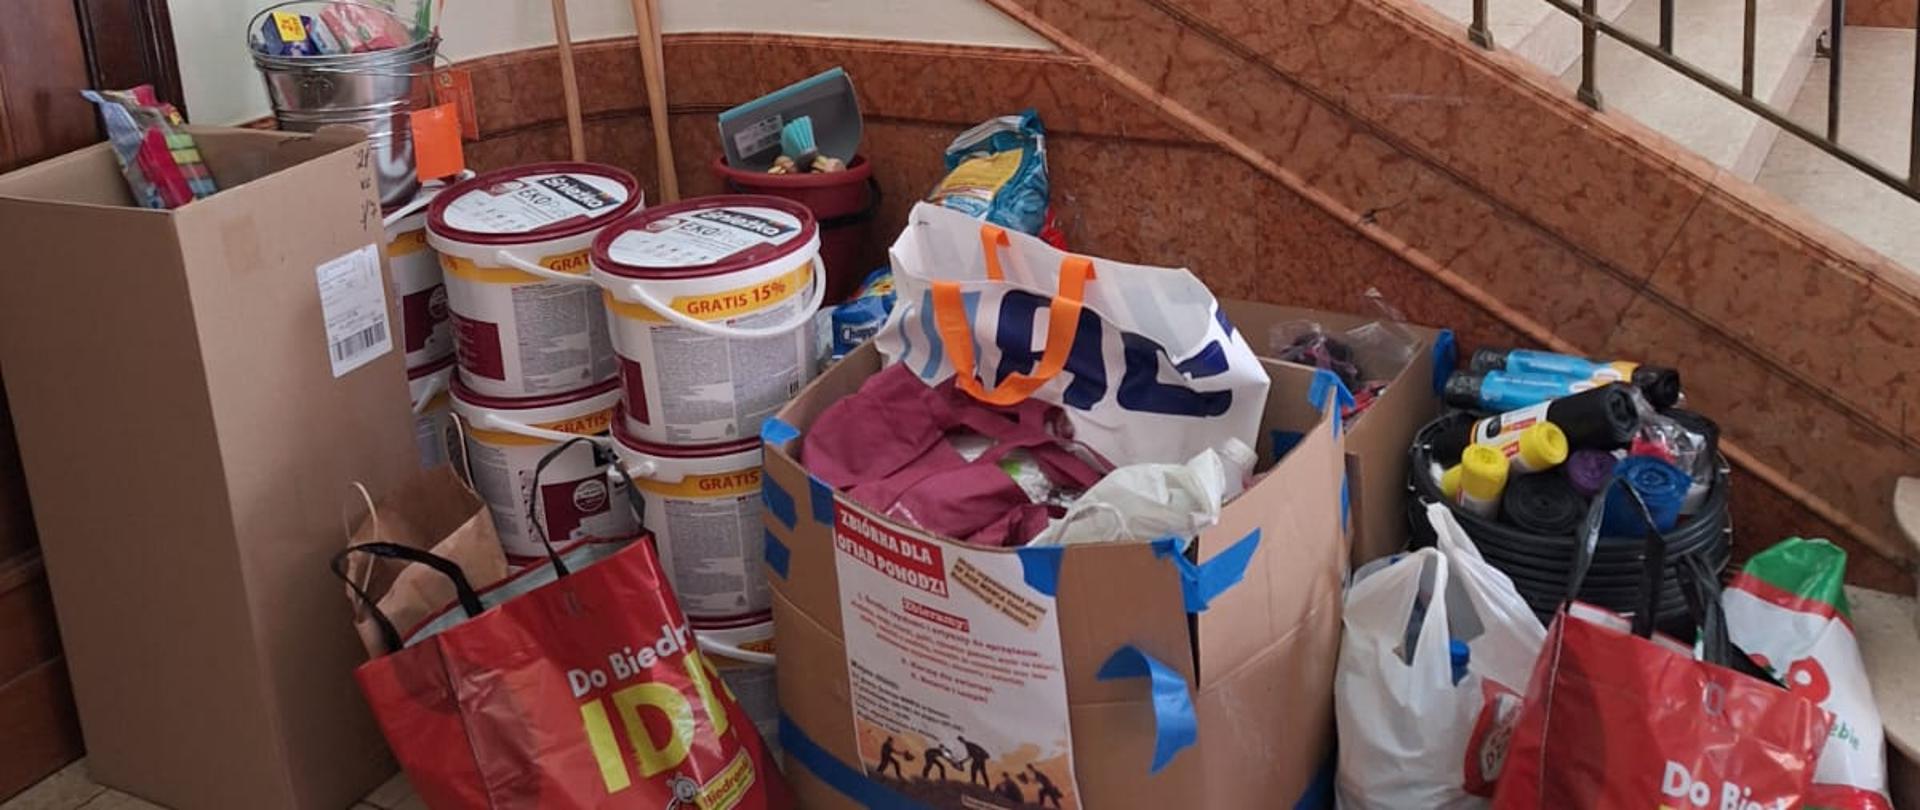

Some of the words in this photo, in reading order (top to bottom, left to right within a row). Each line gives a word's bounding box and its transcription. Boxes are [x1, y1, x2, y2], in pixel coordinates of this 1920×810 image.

[687, 297, 748, 316] GRATIS
[752, 281, 786, 304] 15%
[699, 469, 760, 491] GRATIS
[840, 509, 899, 553] ZBIÓRKA
[899, 540, 934, 566] DLA
[837, 534, 877, 567] OFIAR
[877, 553, 947, 595] POWODZI
[567, 668, 608, 698] Do
[1661, 759, 1711, 807] Do
